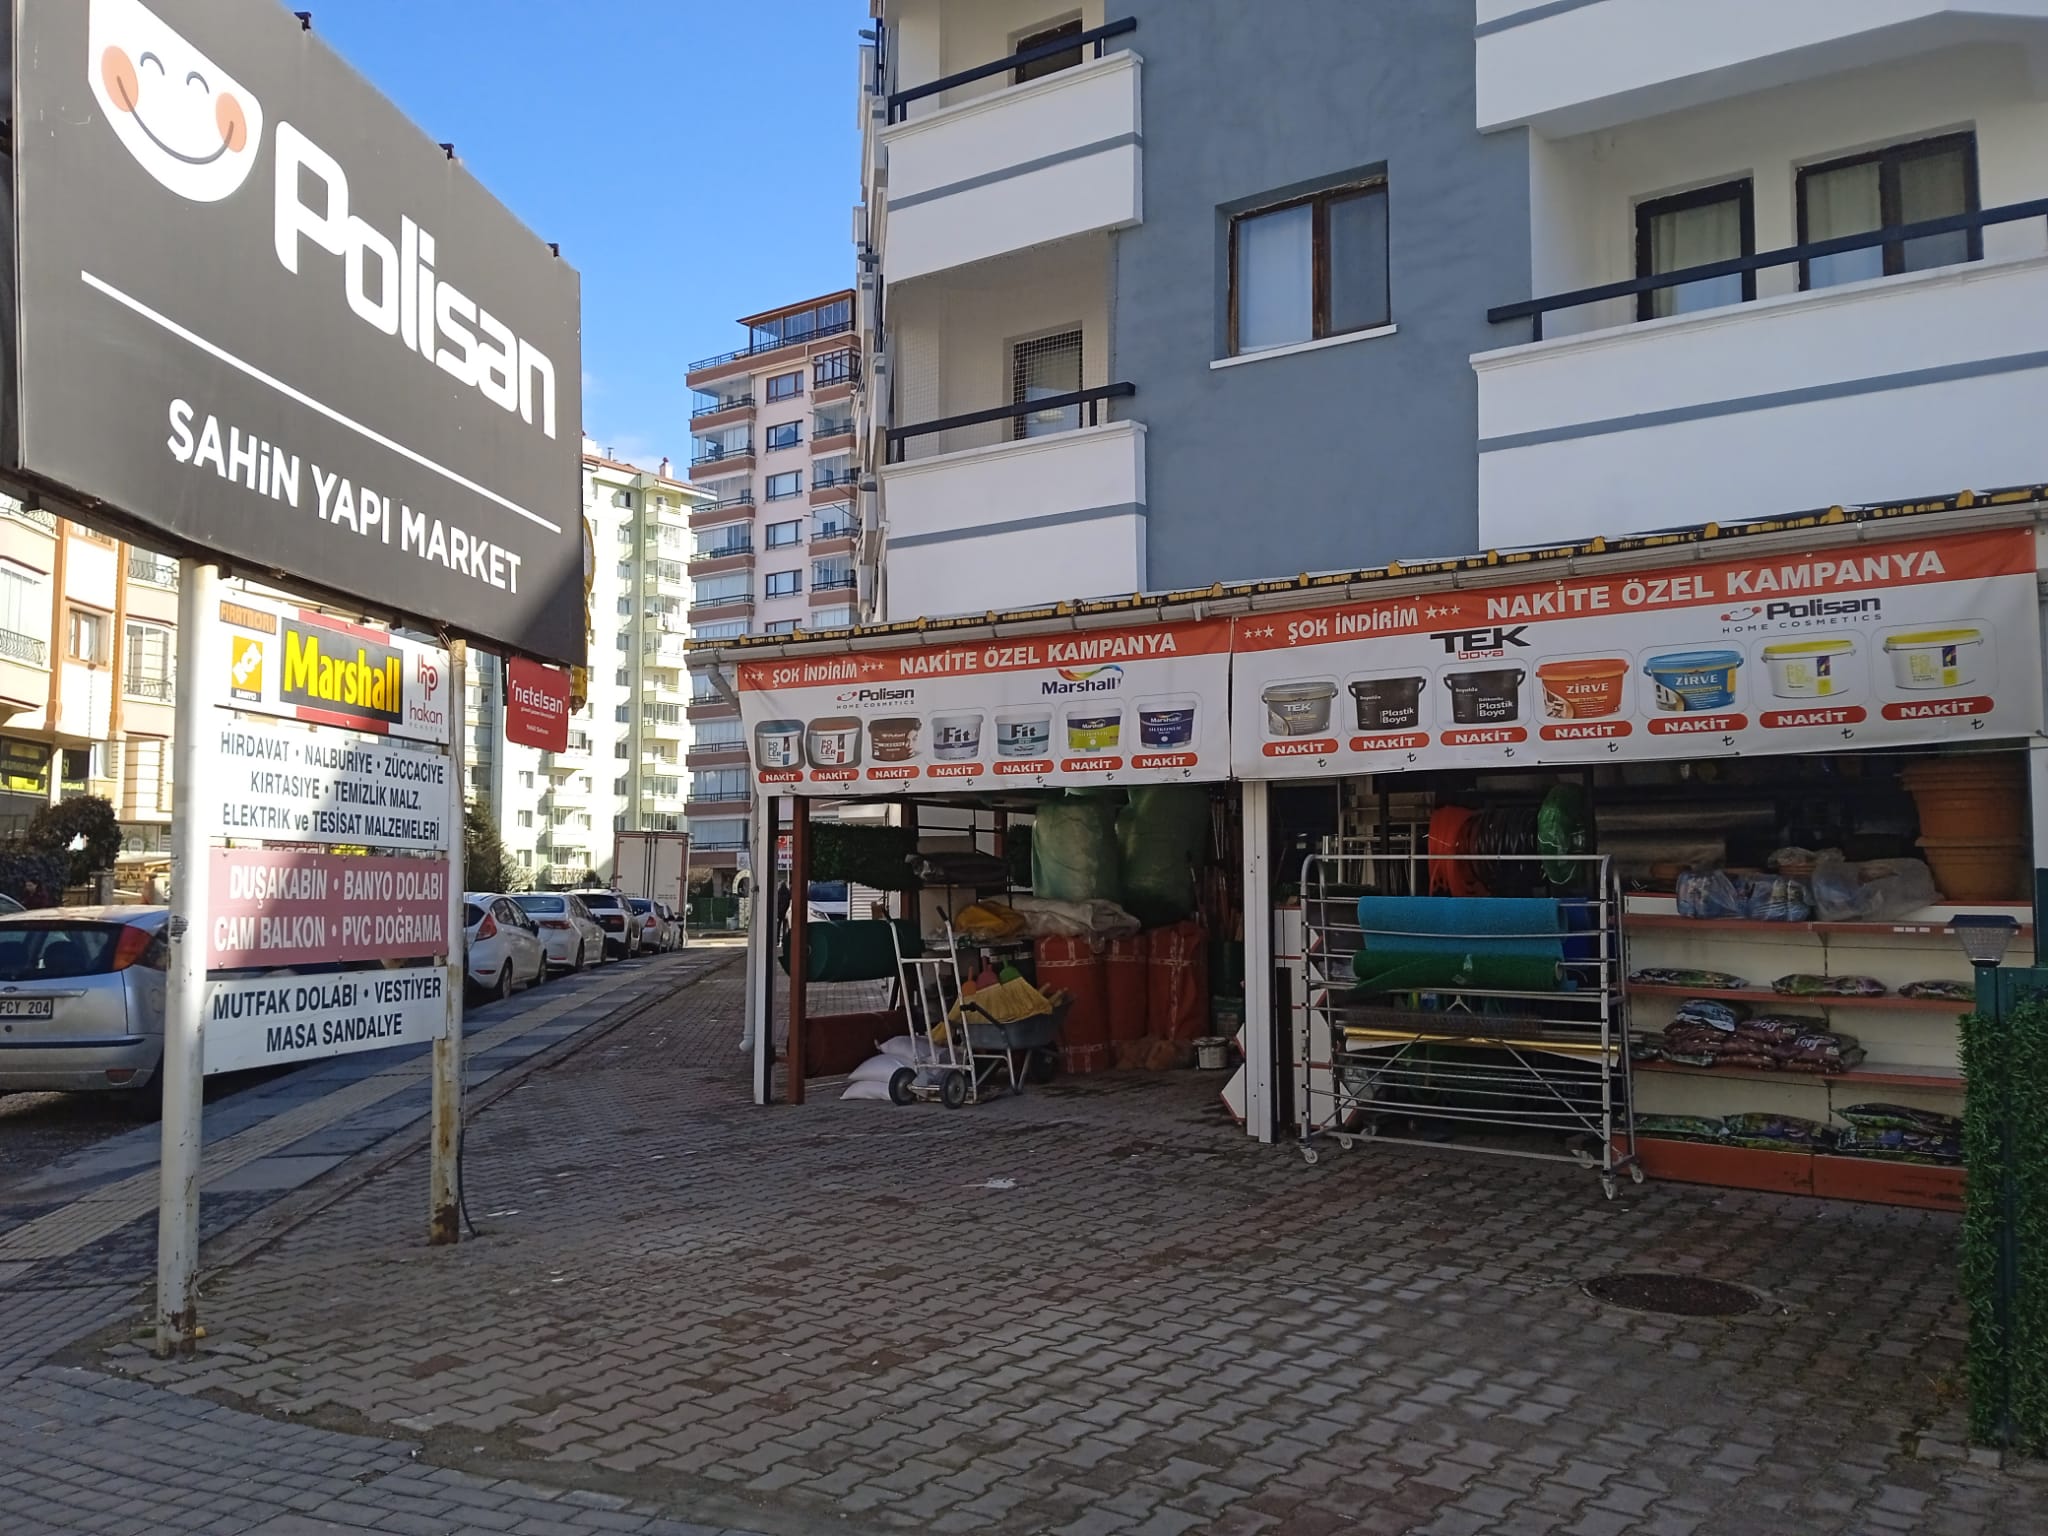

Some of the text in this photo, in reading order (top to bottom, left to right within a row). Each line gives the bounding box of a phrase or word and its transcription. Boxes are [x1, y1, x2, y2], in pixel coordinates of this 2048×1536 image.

[274, 120, 556, 440] Polisan
[310, 463, 391, 545] YAPI
[401, 505, 522, 594] MARKET
[1288, 550, 1946, 645] ŞOK İNDİRİM NAKİTE ÖZEL KAMPANYA
[1767, 597, 1882, 620] Polisan
[1723, 613, 1882, 634] HOME COSMETICS
[1430, 625, 1531, 653] TEK
[772, 632, 1177, 688] ŞOK İNDİRİM NAKİTE ÖZEL KAMPANYA
[1458, 649, 1504, 660] boya
[284, 630, 400, 713] Marshall
[1041, 677, 1117, 695] Marshall
[515, 686, 563, 714] netelsan
[859, 688, 915, 701] Polisan
[864, 700, 915, 709] COSMETICS
[1284, 702, 1312, 712] TEK
[1479, 700, 1513, 710] Plastik
[1900, 701, 1974, 717] NAKİT
[409, 700, 443, 725] hakan
[1382, 707, 1415, 717] Plastik
[1479, 708, 1506, 718] Boya
[1777, 710, 1847, 725] NAKİT
[1382, 716, 1408, 725] Boya
[1664, 718, 1730, 732] NAKİT
[1455, 730, 1513, 743] NAKİT
[1555, 724, 1615, 738] NAKİT
[1275, 743, 1324, 755] NAKİT
[1363, 736, 1415, 749] NAKİT
[221, 731, 444, 784] HIRDAVAT NALBURİYE ZÜCCACİYE
[1142, 755, 1186, 767] NAKİT
[936, 766, 974, 776] NAKİT
[1003, 763, 1044, 773] NAKİT
[1071, 760, 1112, 770] NAKİT
[766, 772, 796, 782] NAKİT
[818, 770, 850, 781] NAKİT
[875, 769, 911, 778] NAKİT
[334, 777, 387, 806] TEMİZLİK
[390, 788, 421, 811] MALZ.
[294, 813, 308, 831] ve
[312, 807, 362, 835] TESİSAT
[364, 814, 439, 841] MALZEMELERİ
[230, 859, 443, 909] DUŞAKABİN BANYO DOLABI
[214, 906, 442, 952] CAM BALKON PVC DOĞRAMA
[213, 973, 442, 1020] MUTFAK DOLABI VESTİYER
[28, 1001, 49, 1014] 204
[267, 1013, 403, 1052] MASA SANDALYE
